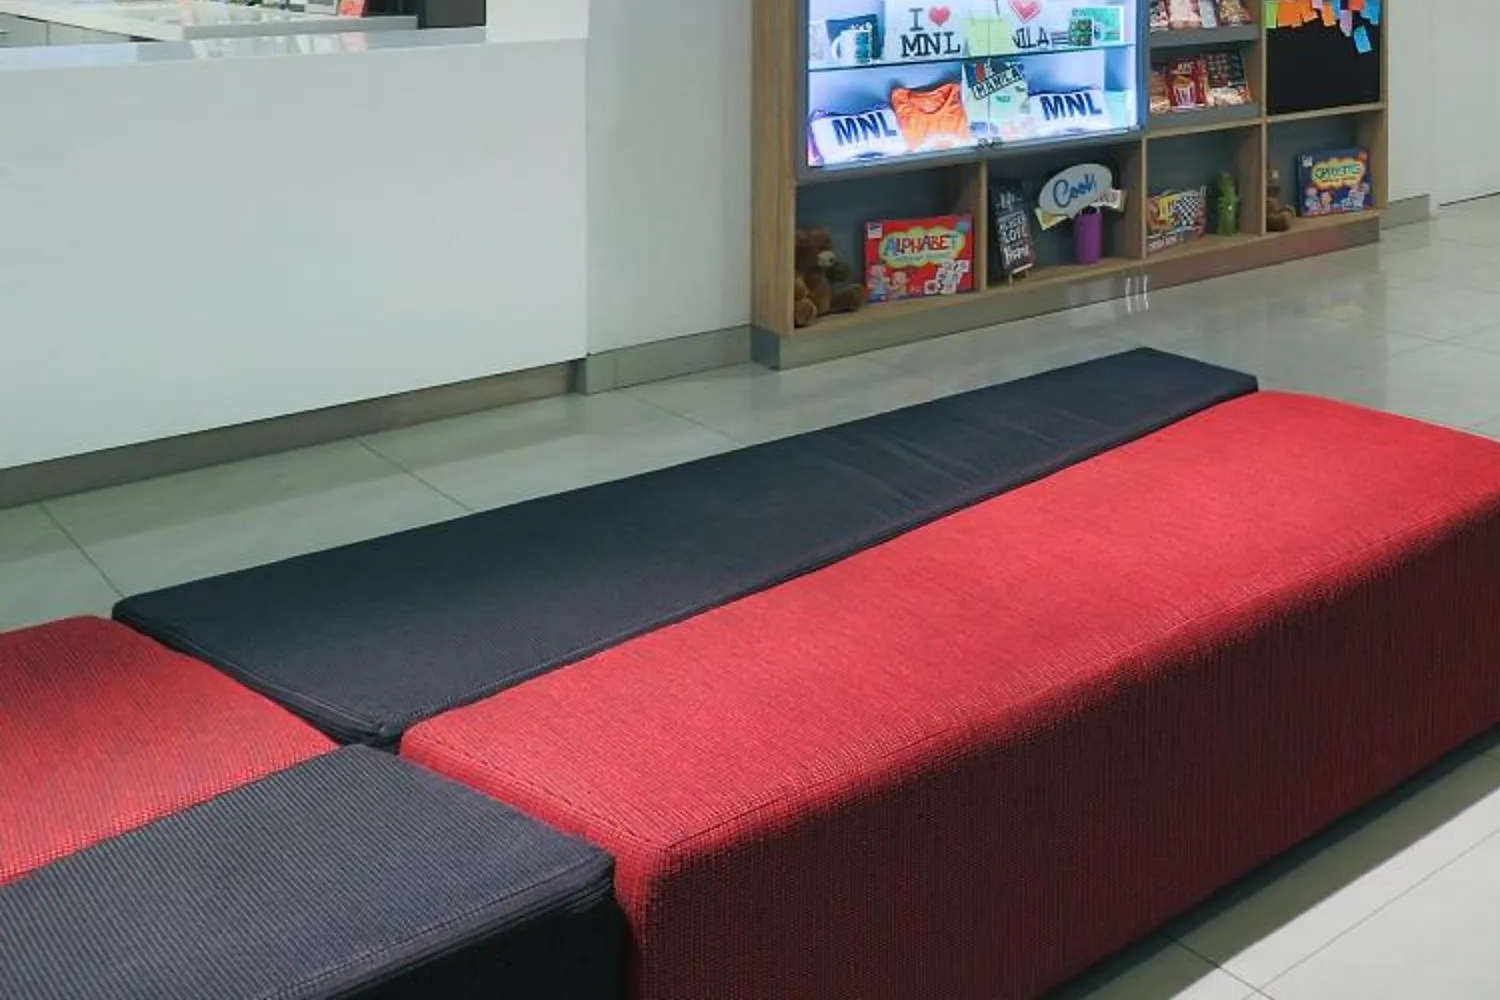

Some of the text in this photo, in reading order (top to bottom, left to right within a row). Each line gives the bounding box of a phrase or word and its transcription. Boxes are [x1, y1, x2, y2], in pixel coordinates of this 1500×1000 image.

[909, 7, 924, 32] I
[900, 31, 961, 58] MNL
[1039, 92, 1102, 121] MNL
[831, 111, 897, 146] MNL
[882, 231, 960, 257] ALPHABET
